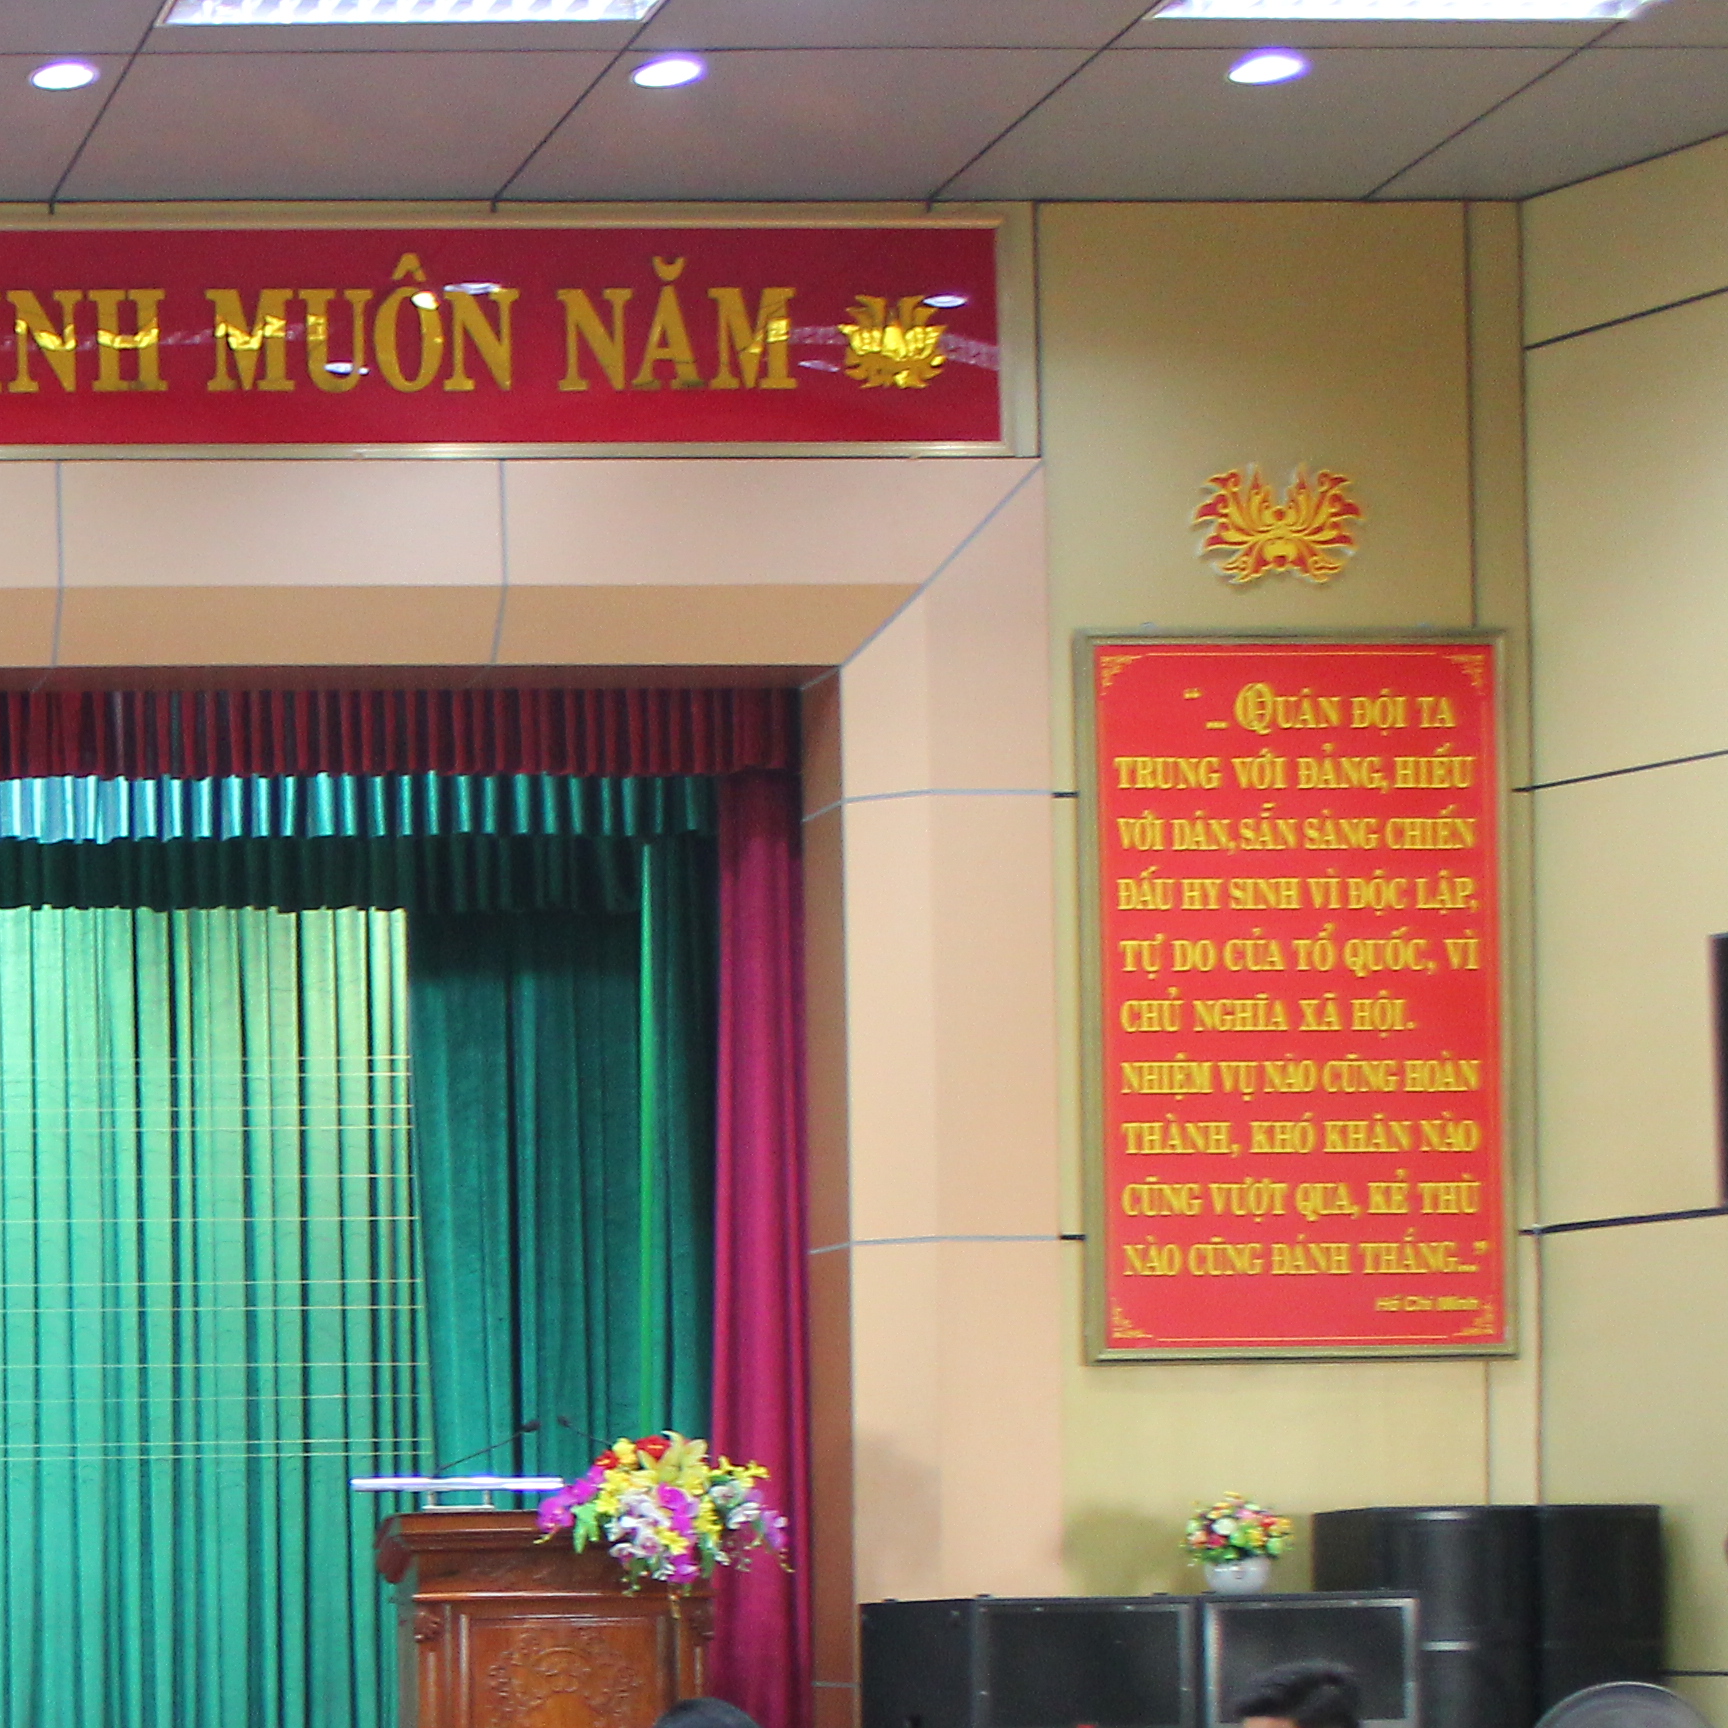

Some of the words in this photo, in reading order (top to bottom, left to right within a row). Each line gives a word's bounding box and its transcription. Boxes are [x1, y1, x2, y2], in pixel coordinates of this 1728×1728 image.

[204, 252, 521, 393] MUÔN
[555, 254, 804, 391] NĂM
[1351, 689, 1409, 734] ĐỘI
[1416, 696, 1456, 728] TA
[1114, 756, 1223, 789] TRUNG
[1231, 748, 1288, 789] VỚI
[1297, 743, 1392, 793] ĐẢNG,
[1393, 743, 1476, 788] HIẾU
[1117, 811, 1166, 850] VỚI
[1238, 802, 1299, 850] SẴN
[1303, 810, 1384, 849] SÀNG
[1383, 806, 1477, 849] CHIẾN
[1118, 866, 1179, 910] ĐẤU
[1179, 878, 1224, 910] HY
[1228, 877, 1302, 909] SINH
[1307, 869, 1343, 909] VÌ
[1346, 870, 1409, 915] ĐỘC
[1119, 934, 1166, 978] TỰ
[1172, 939, 1219, 971] DO
[1222, 928, 1286, 971] CỦA
[1293, 923, 1338, 971] TỔ
[1342, 927, 1438, 977] QUỐC,
[1445, 930, 1481, 969] VÌ
[1120, 987, 1184, 1032] CHỦ
[1193, 993, 1290, 1031] NGHĨA
[1299, 992, 1344, 1031] XÃ
[1121, 1052, 1215, 1100] NHIỆM
[1215, 1061, 1260, 1101] VỤ
[1261, 1055, 1319, 1092] NÀO
[1318, 1054, 1400, 1092] CŨNG
[1404, 1051, 1482, 1092] HOÀN
[1121, 1114, 1242, 1156] THÀNH,
[1250, 1113, 1318, 1153] KHÓ
[1324, 1113, 1413, 1152] KHĂN
[1419, 1112, 1482, 1152] NÀO
[1122, 1176, 1203, 1216] CŨNG
[1208, 1177, 1289, 1222] VƯỢT
[1367, 1169, 1411, 1214] KẺ
[1417, 1174, 1482, 1214] THÙ
[1124, 1236, 1184, 1276] NÀO
[1187, 1237, 1264, 1276] CŨNG
[1271, 1235, 1352, 1274] ĐÁNH
